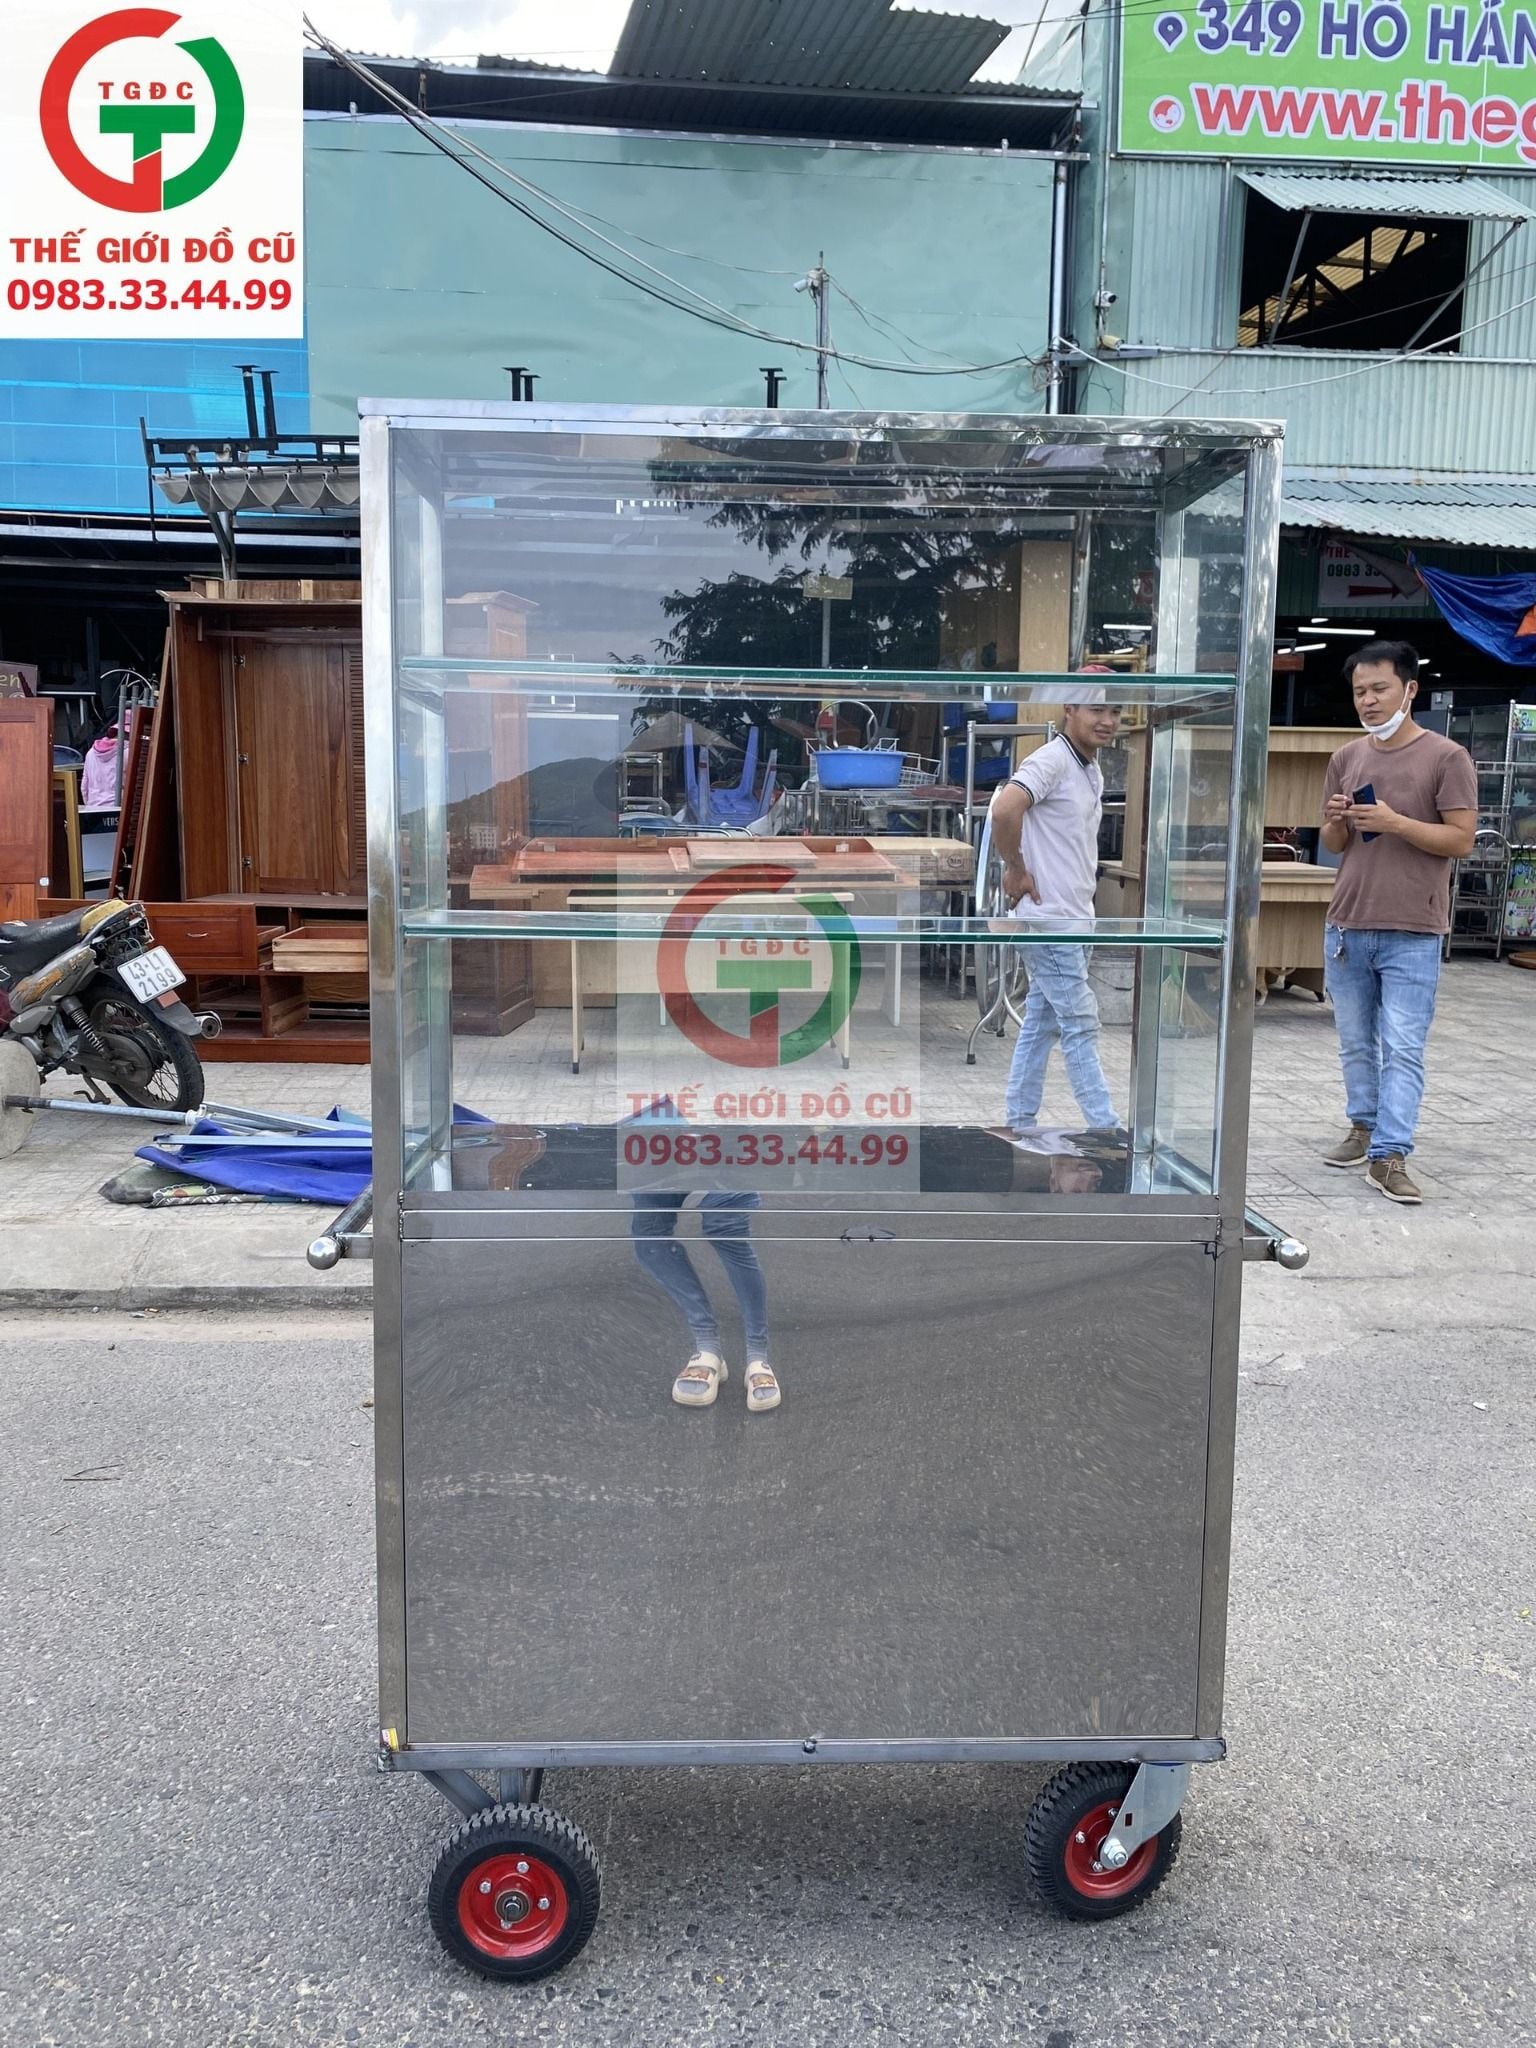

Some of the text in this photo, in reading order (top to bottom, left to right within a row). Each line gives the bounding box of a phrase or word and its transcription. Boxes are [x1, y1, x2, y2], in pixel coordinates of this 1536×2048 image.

[1199, 0, 1300, 53] 349
[1327, 564, 1360, 577] 0983
[138, 967, 177, 998] 2199
